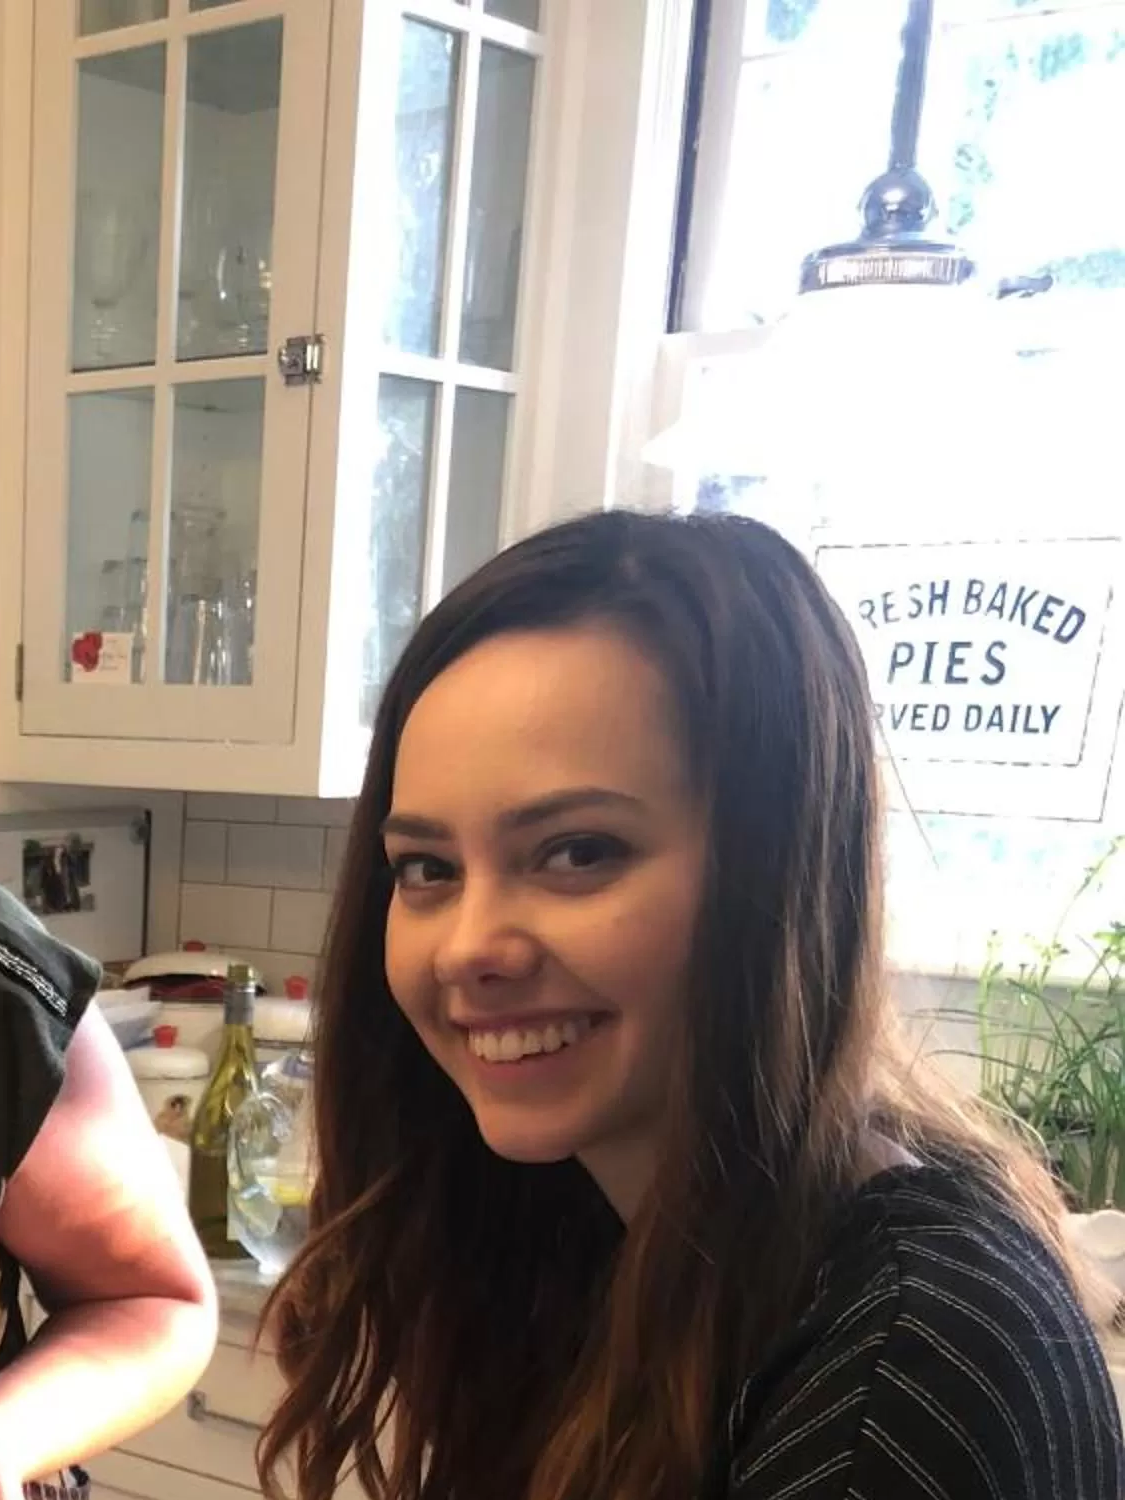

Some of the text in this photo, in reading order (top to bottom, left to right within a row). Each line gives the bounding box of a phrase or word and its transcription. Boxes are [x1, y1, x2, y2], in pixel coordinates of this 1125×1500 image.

[859, 578, 1087, 644] RESH BAKED
[887, 640, 1008, 686] PIES
[872, 703, 1061, 734] RVED DAILY
